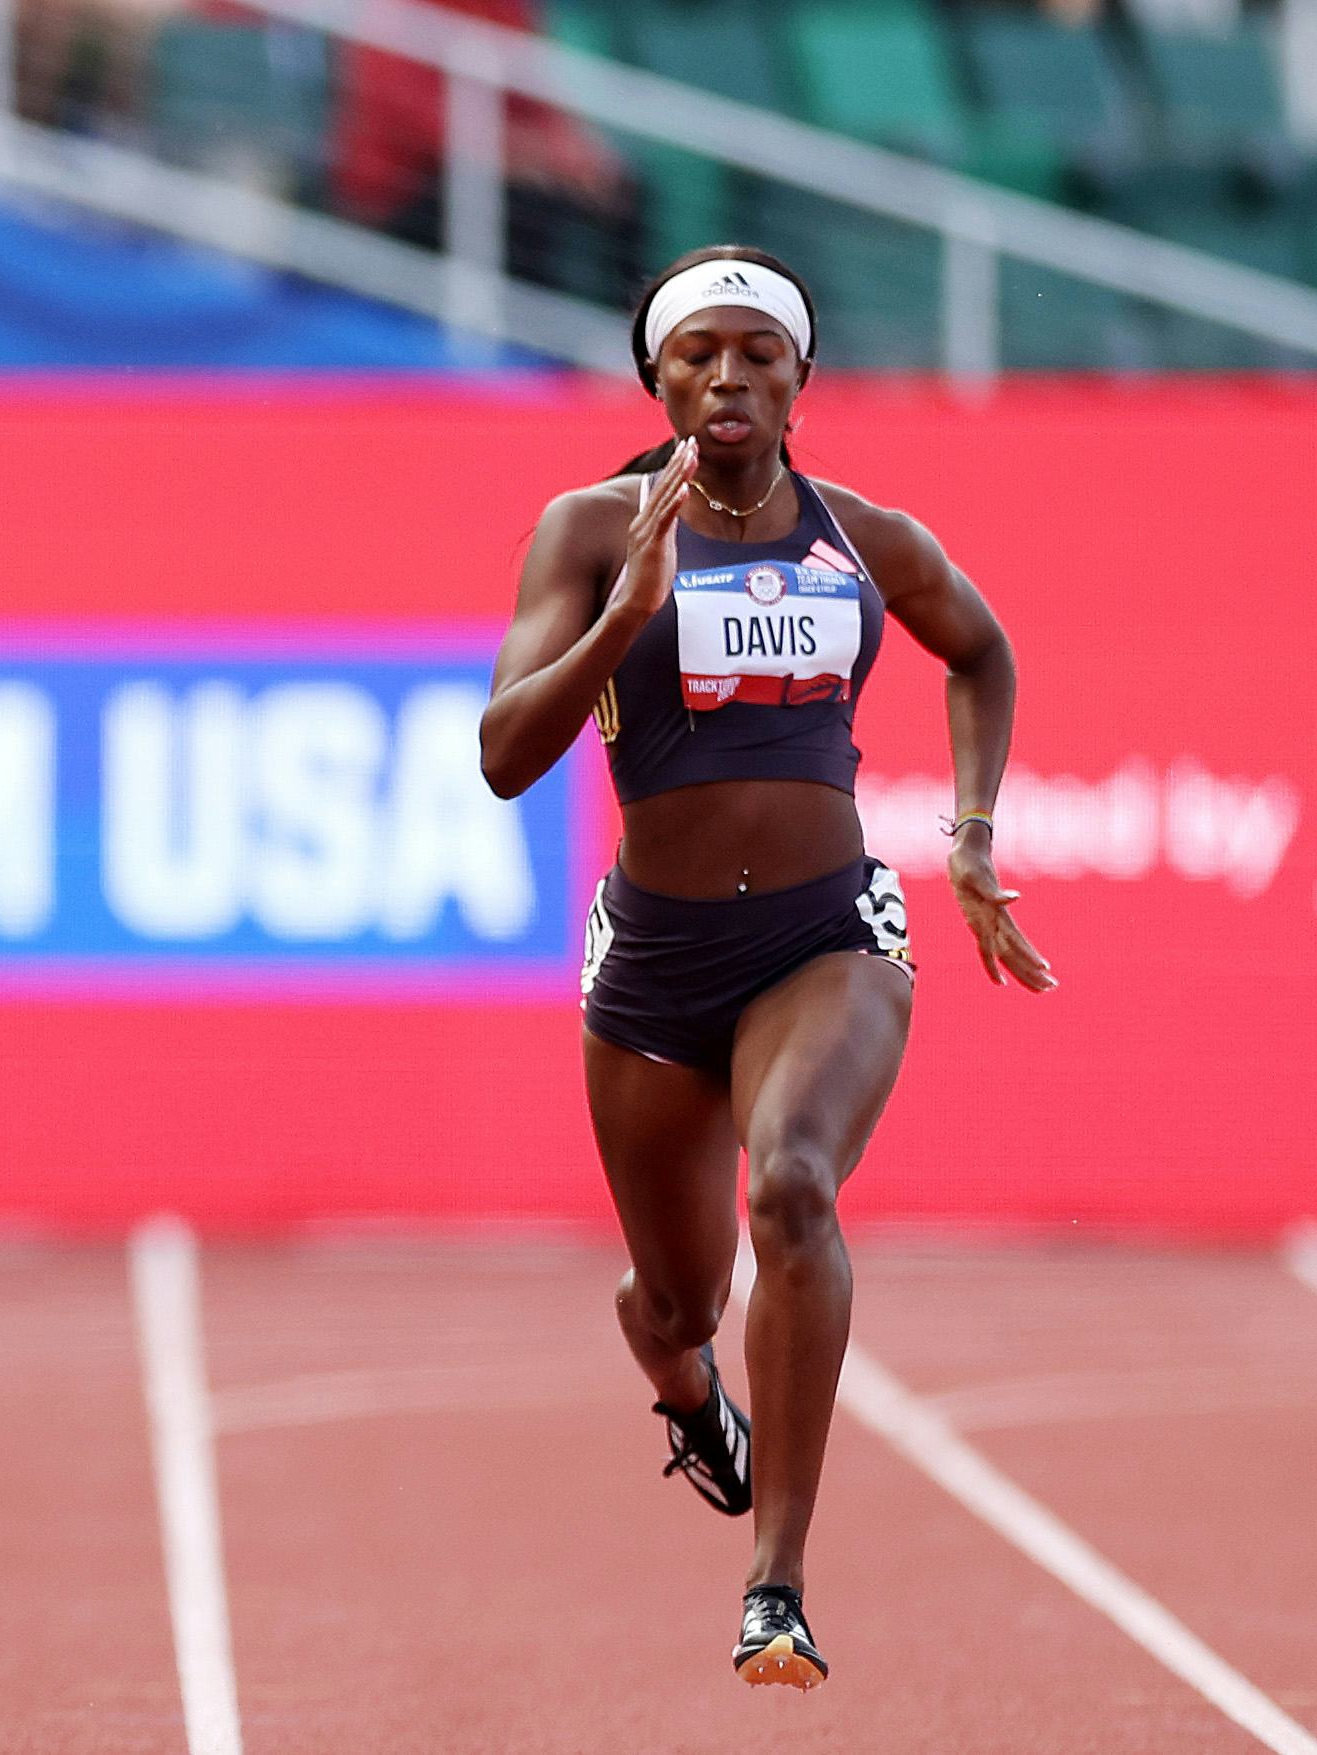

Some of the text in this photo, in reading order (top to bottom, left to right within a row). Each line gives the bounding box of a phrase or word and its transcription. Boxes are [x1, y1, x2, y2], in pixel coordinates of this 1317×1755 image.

[701, 284, 760, 299] adidas
[723, 615, 817, 657] DAVIS
[687, 676, 741, 696] TRACKT
[100, 673, 538, 941] USA
